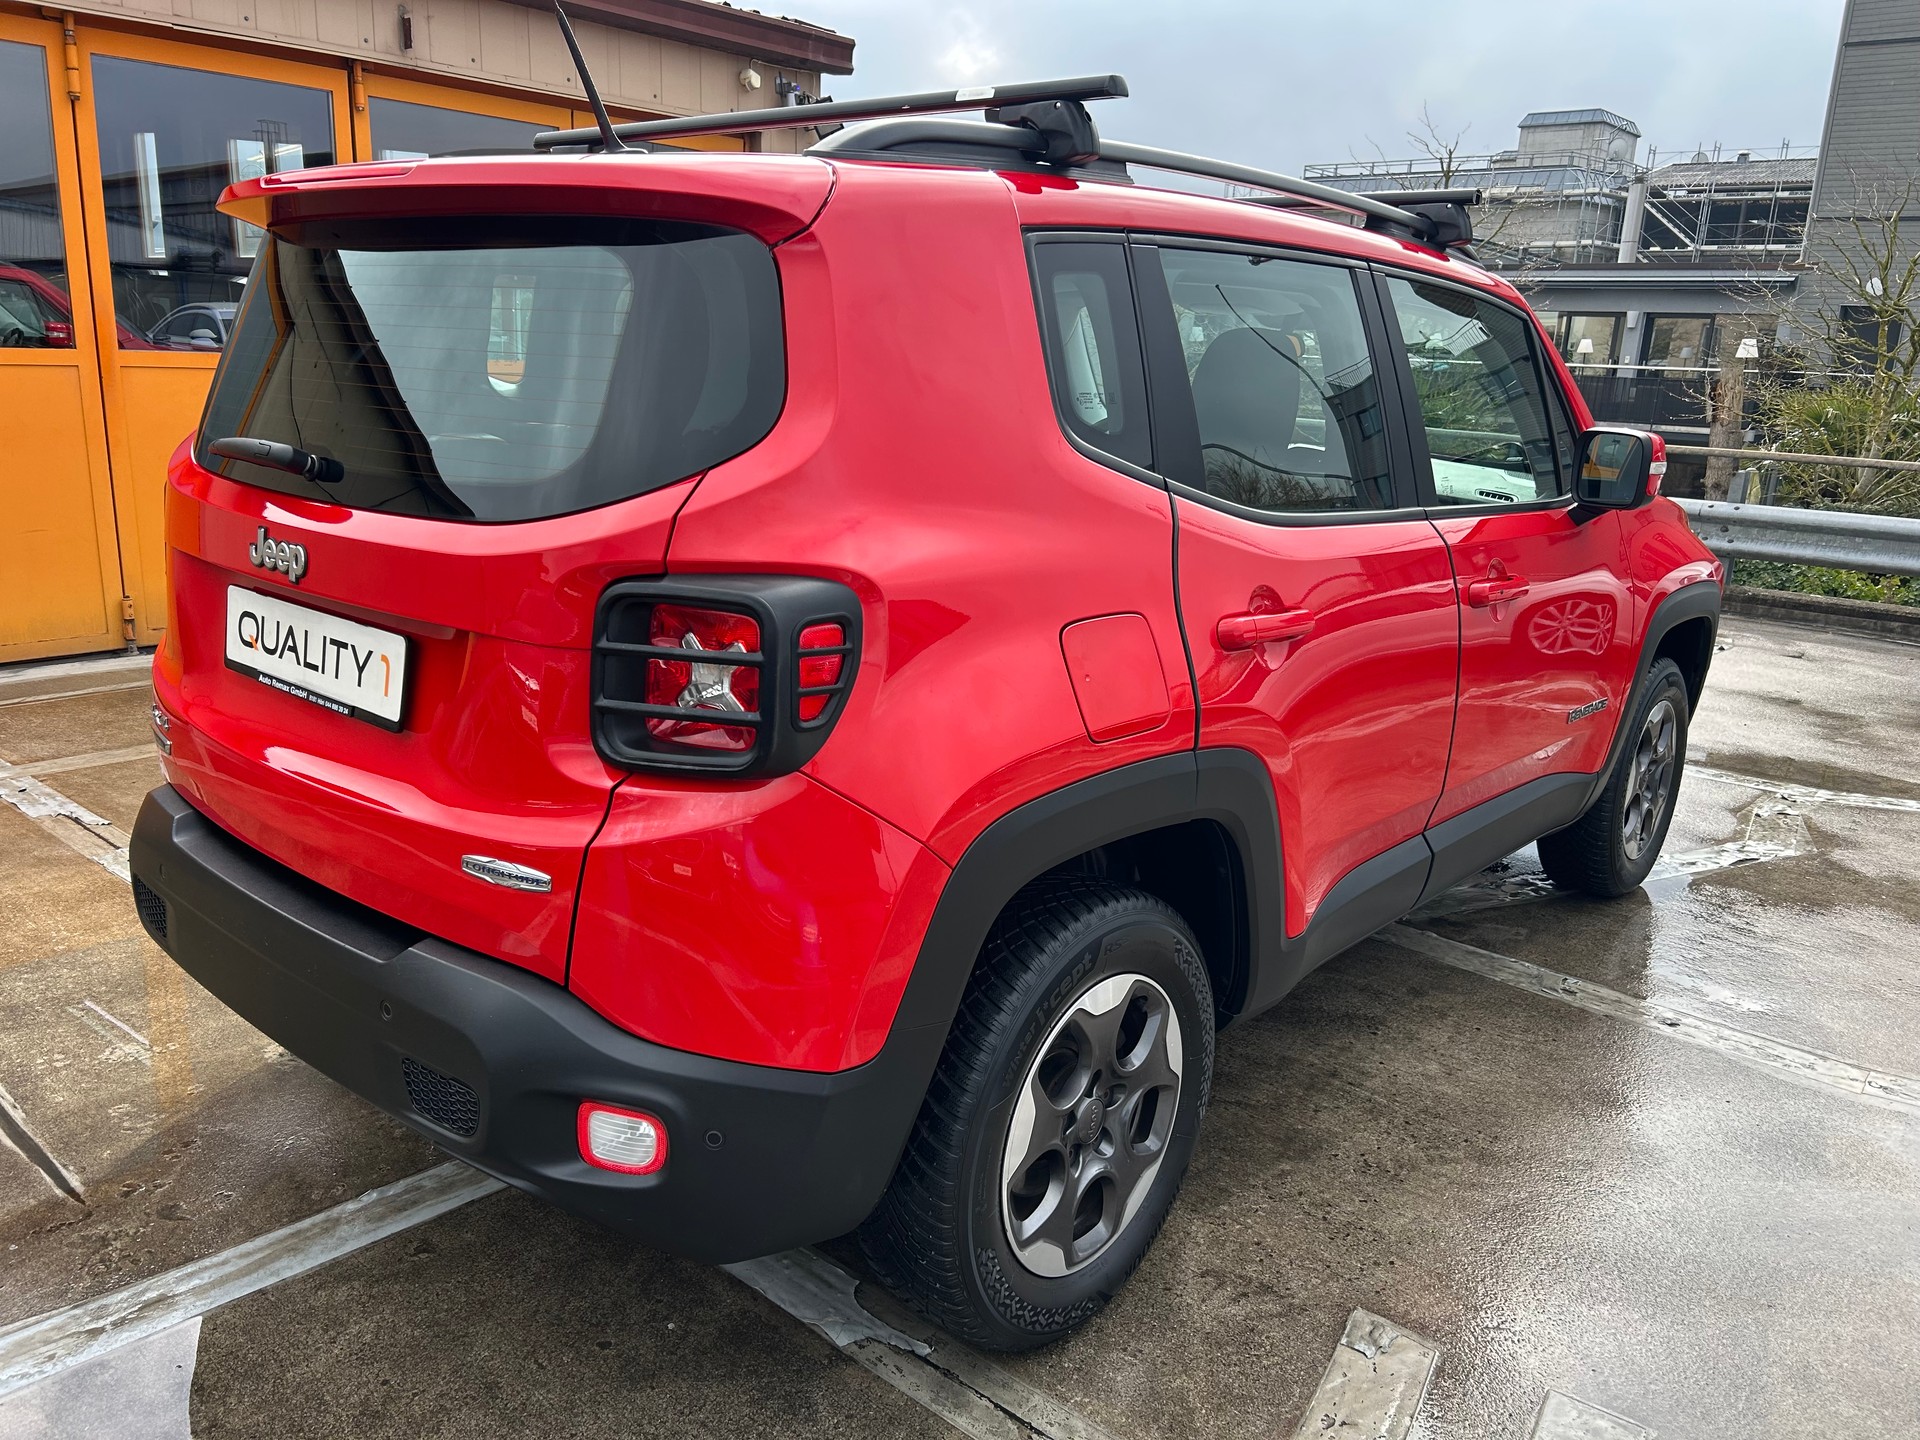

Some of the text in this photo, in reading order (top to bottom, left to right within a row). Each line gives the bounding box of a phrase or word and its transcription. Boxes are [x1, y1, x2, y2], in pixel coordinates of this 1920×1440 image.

[250, 526, 307, 584] Jeep
[238, 610, 374, 688] QUALITY
[259, 674, 308, 699] Auto Remax GmbH
[1568, 697, 1609, 724] RENEGADE
[463, 860, 551, 887] LONGITUDE
